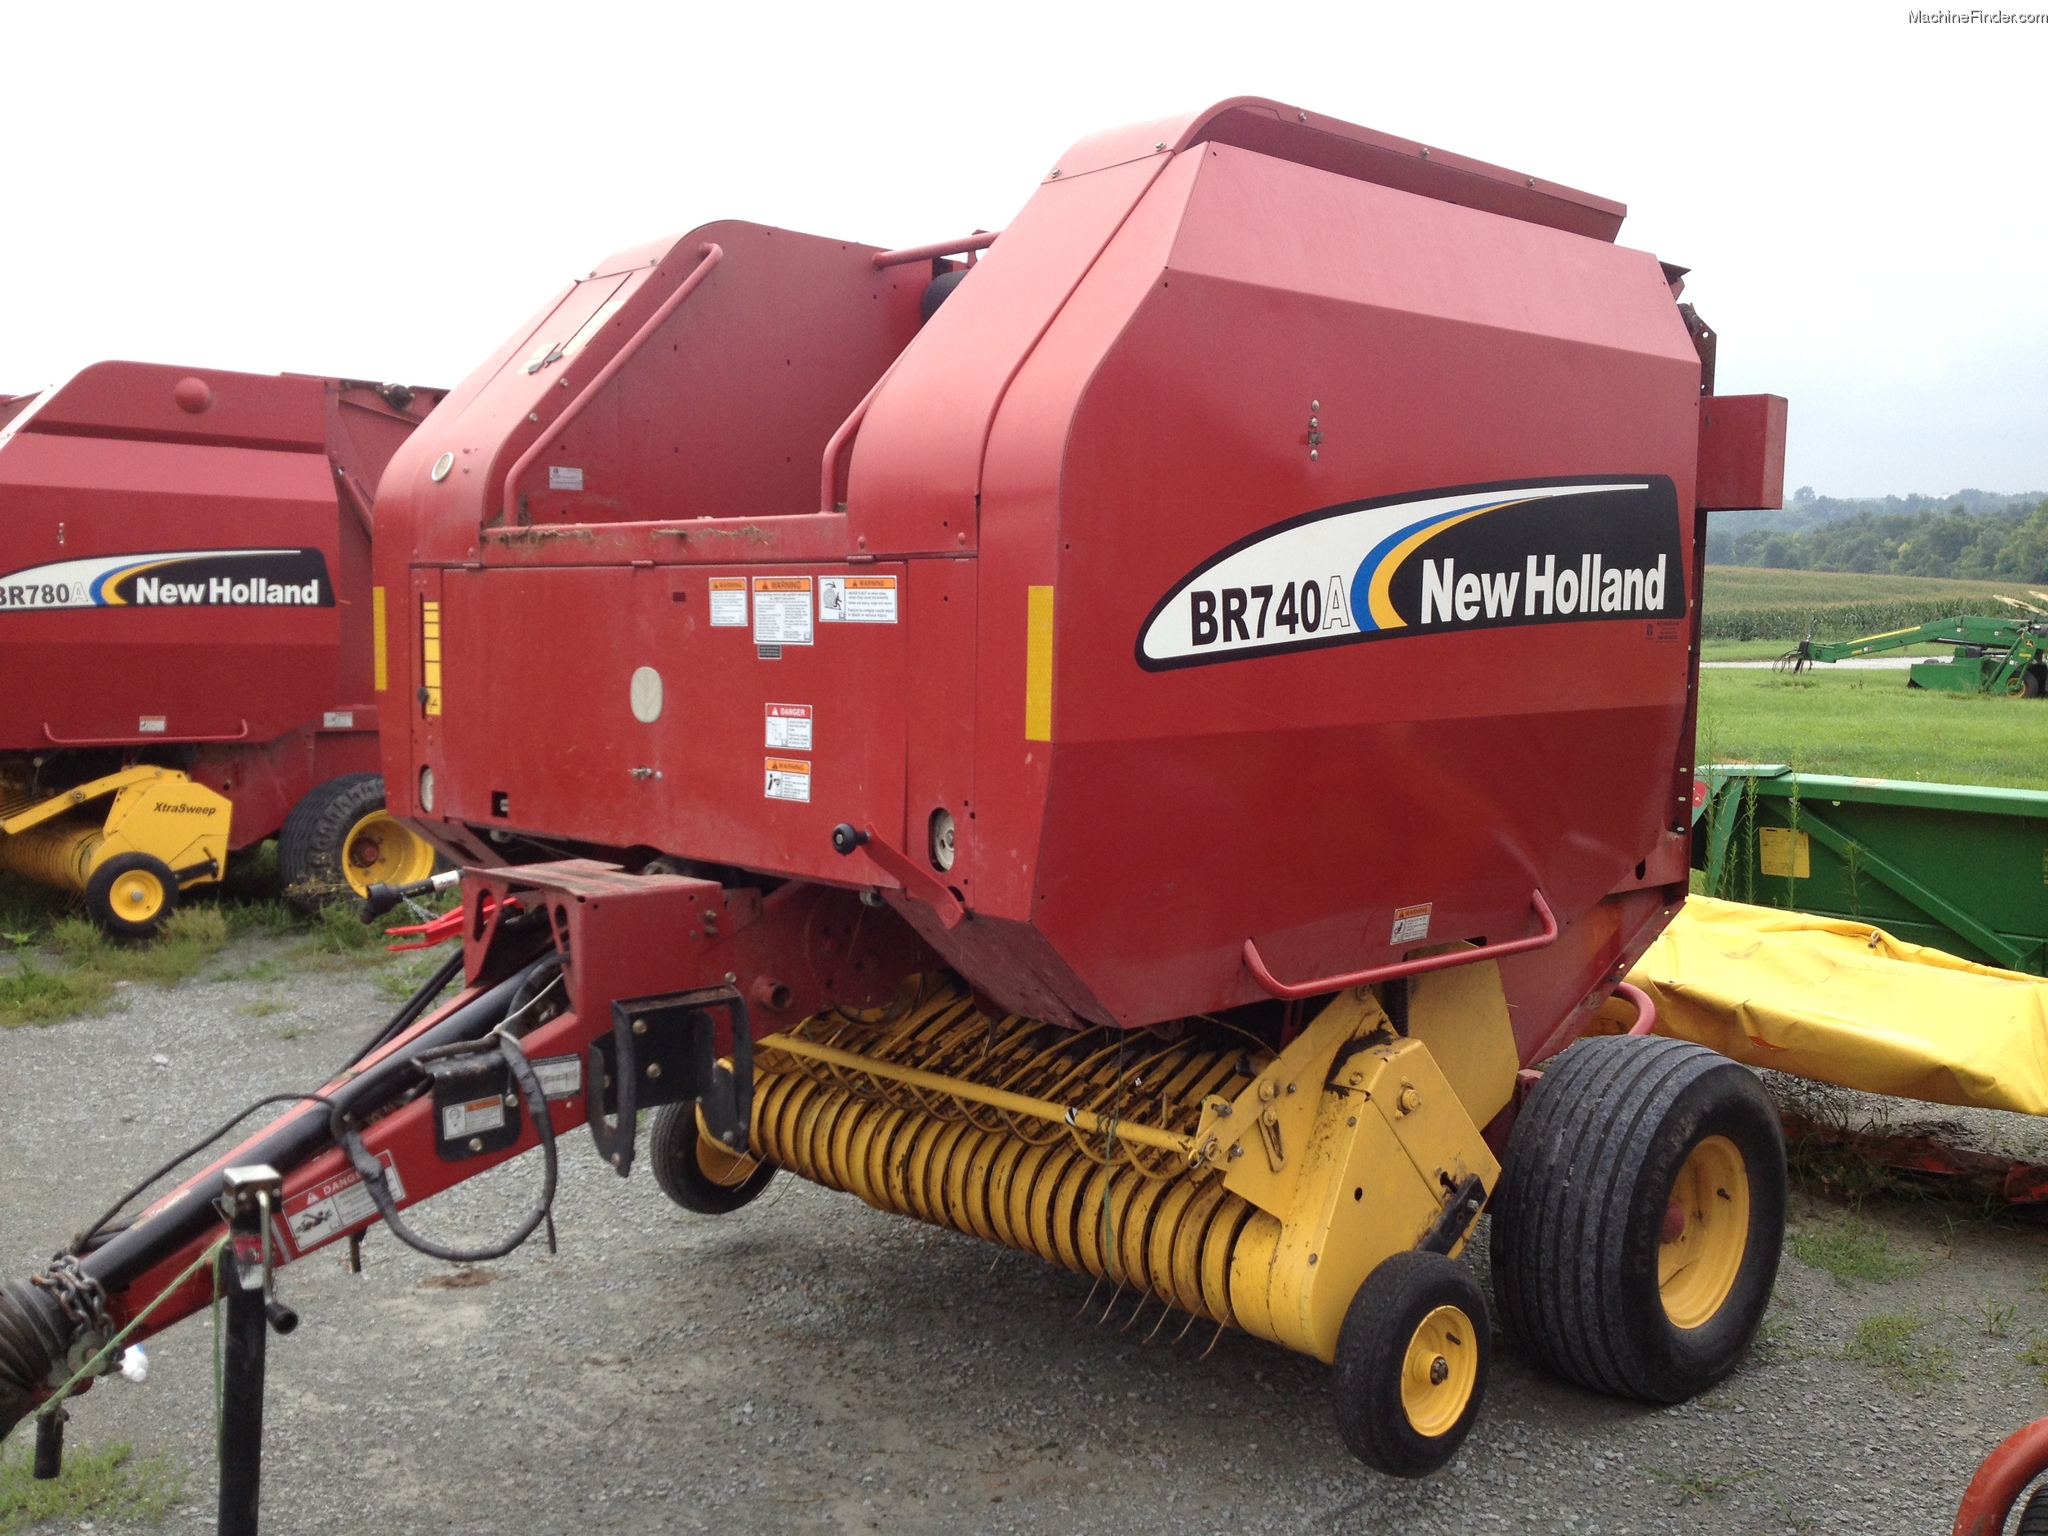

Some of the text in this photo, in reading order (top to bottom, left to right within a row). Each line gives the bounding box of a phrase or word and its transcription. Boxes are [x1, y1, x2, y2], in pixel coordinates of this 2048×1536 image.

[136, 577, 319, 604] New Holland
[771, 580, 802, 589] WARNING
[1421, 553, 1667, 624] New Holland
[1191, 575, 1350, 646] BR740A
[780, 707, 805, 716] DANGER
[779, 762, 805, 771] WARNING
[153, 802, 216, 816] XtraSweep
